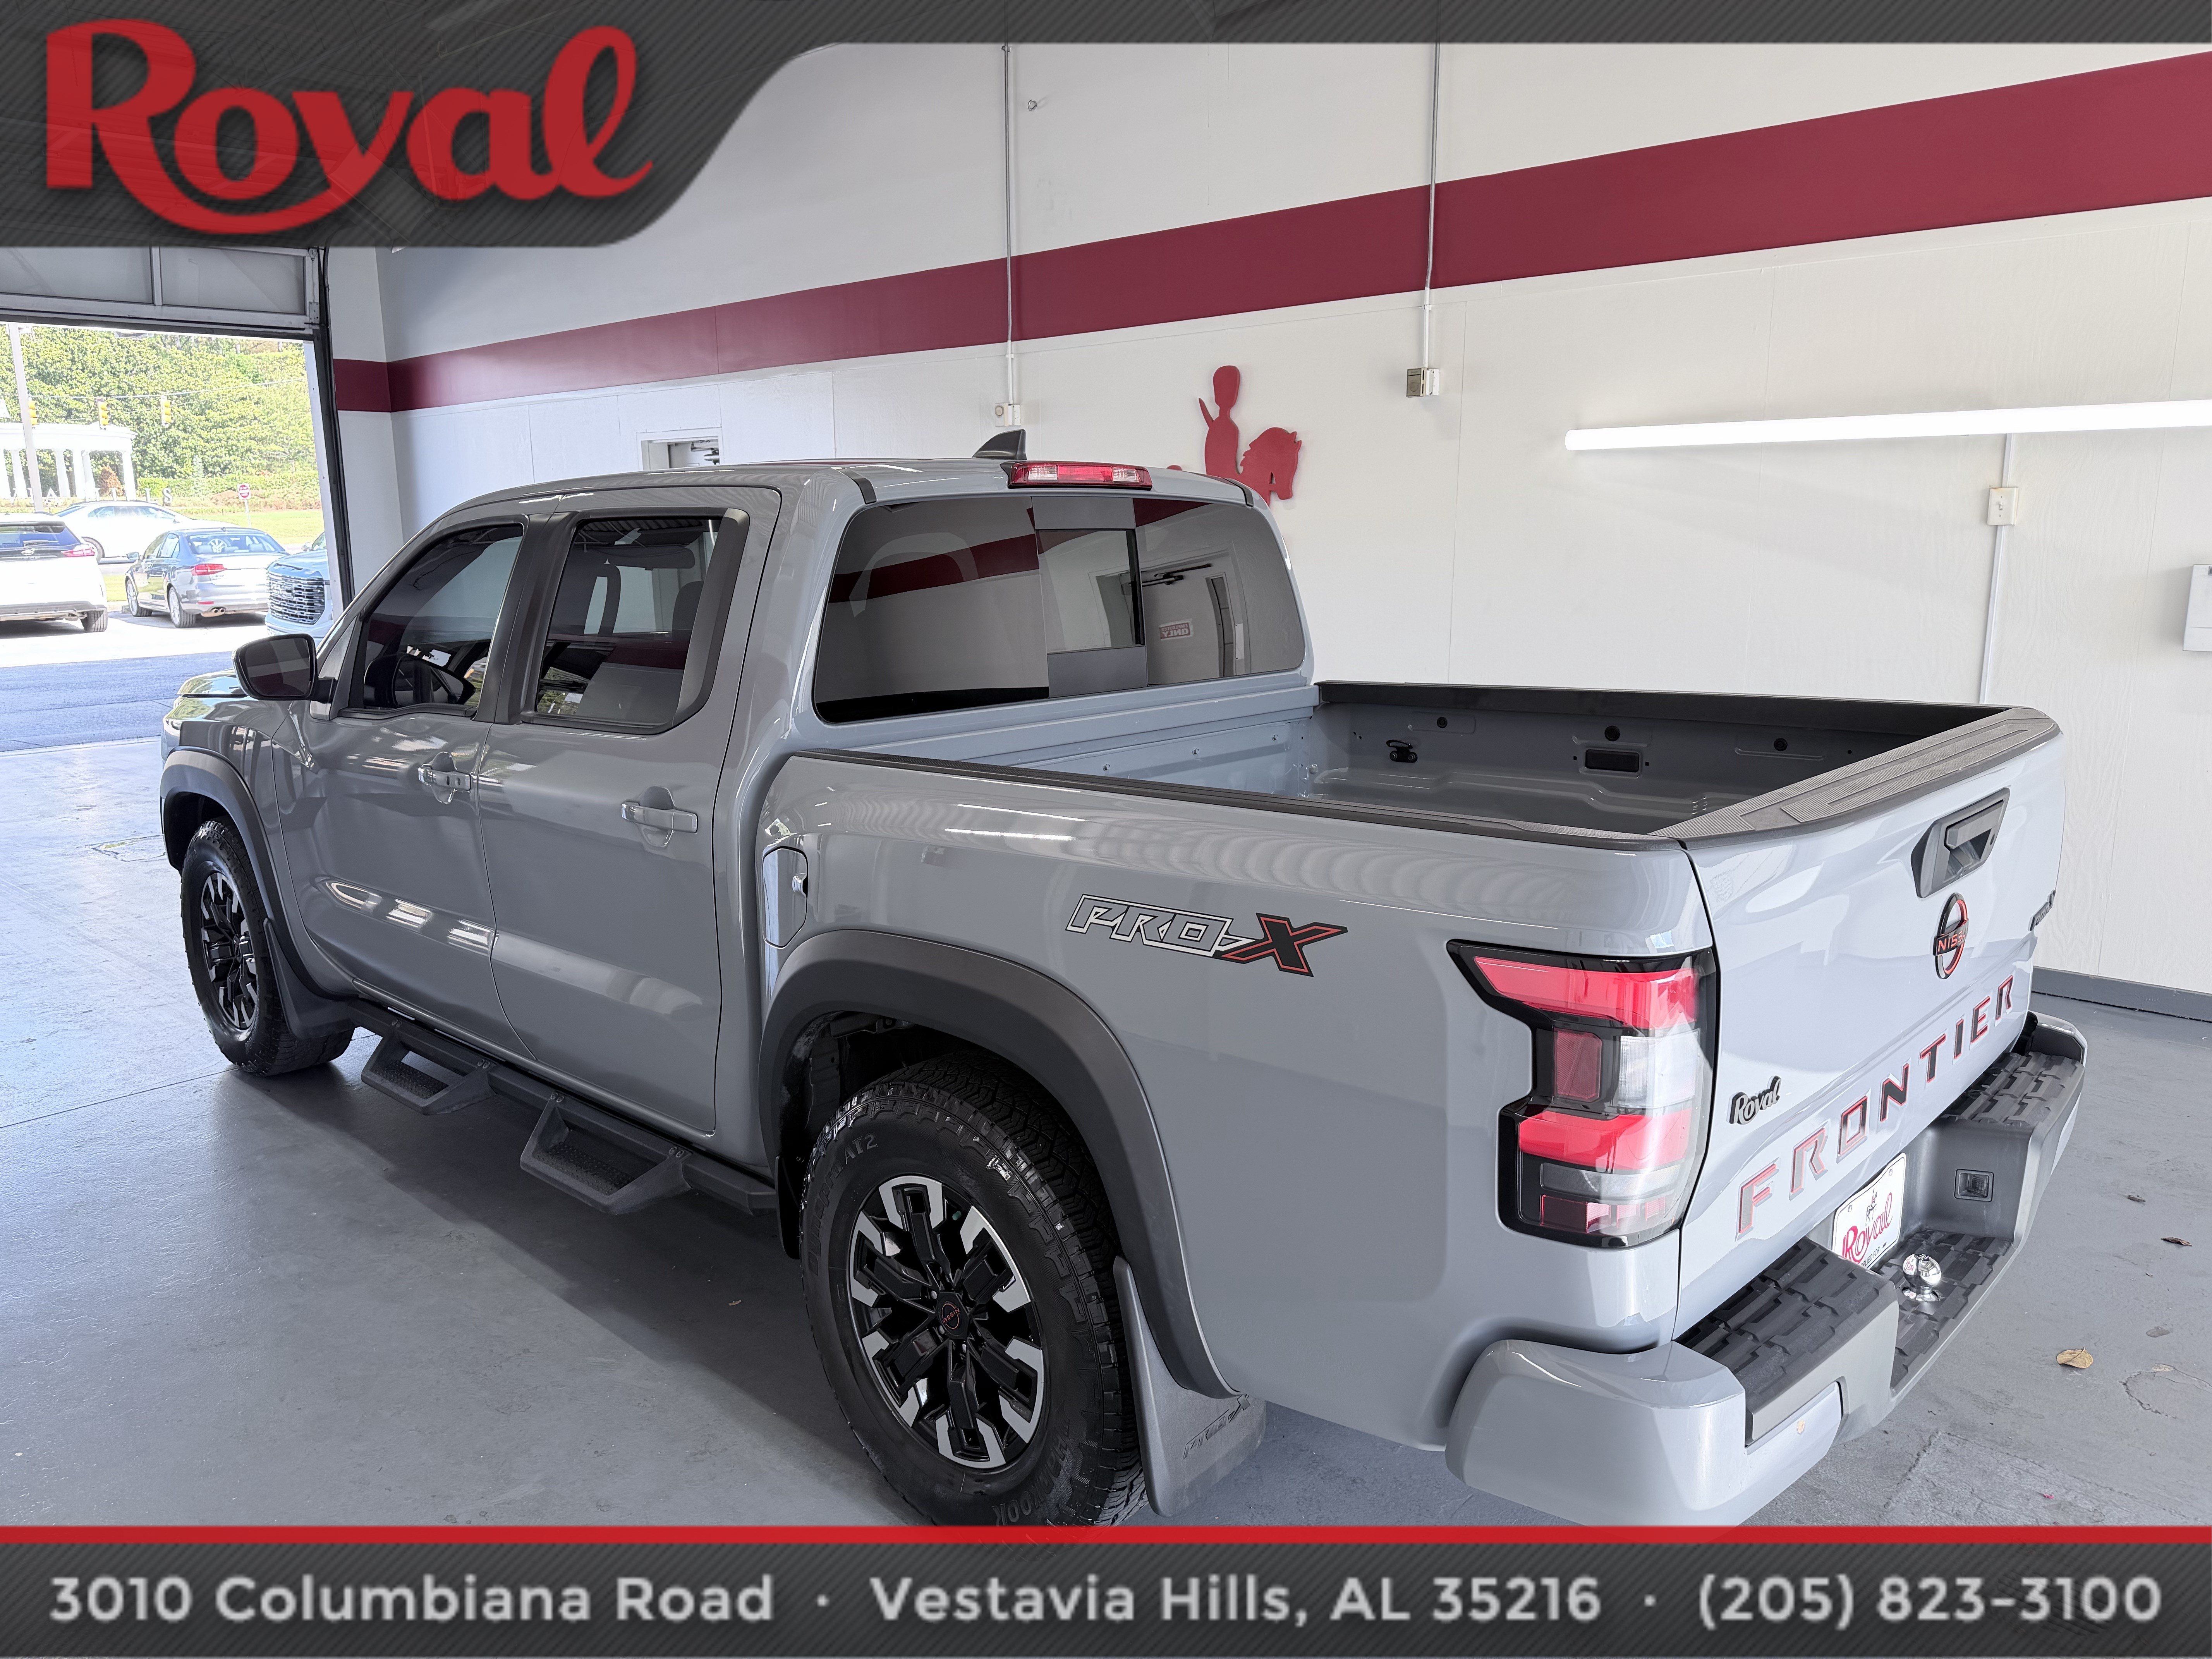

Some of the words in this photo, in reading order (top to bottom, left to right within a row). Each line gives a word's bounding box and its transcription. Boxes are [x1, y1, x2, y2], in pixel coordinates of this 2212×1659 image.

[1937, 929, 1967, 952] NISS
[1728, 1075, 1781, 1125] Royal
[1738, 974, 2014, 1234] FRONTIER
[845, 1133, 878, 1164] AT2
[1842, 1192, 1893, 1264] Royal
